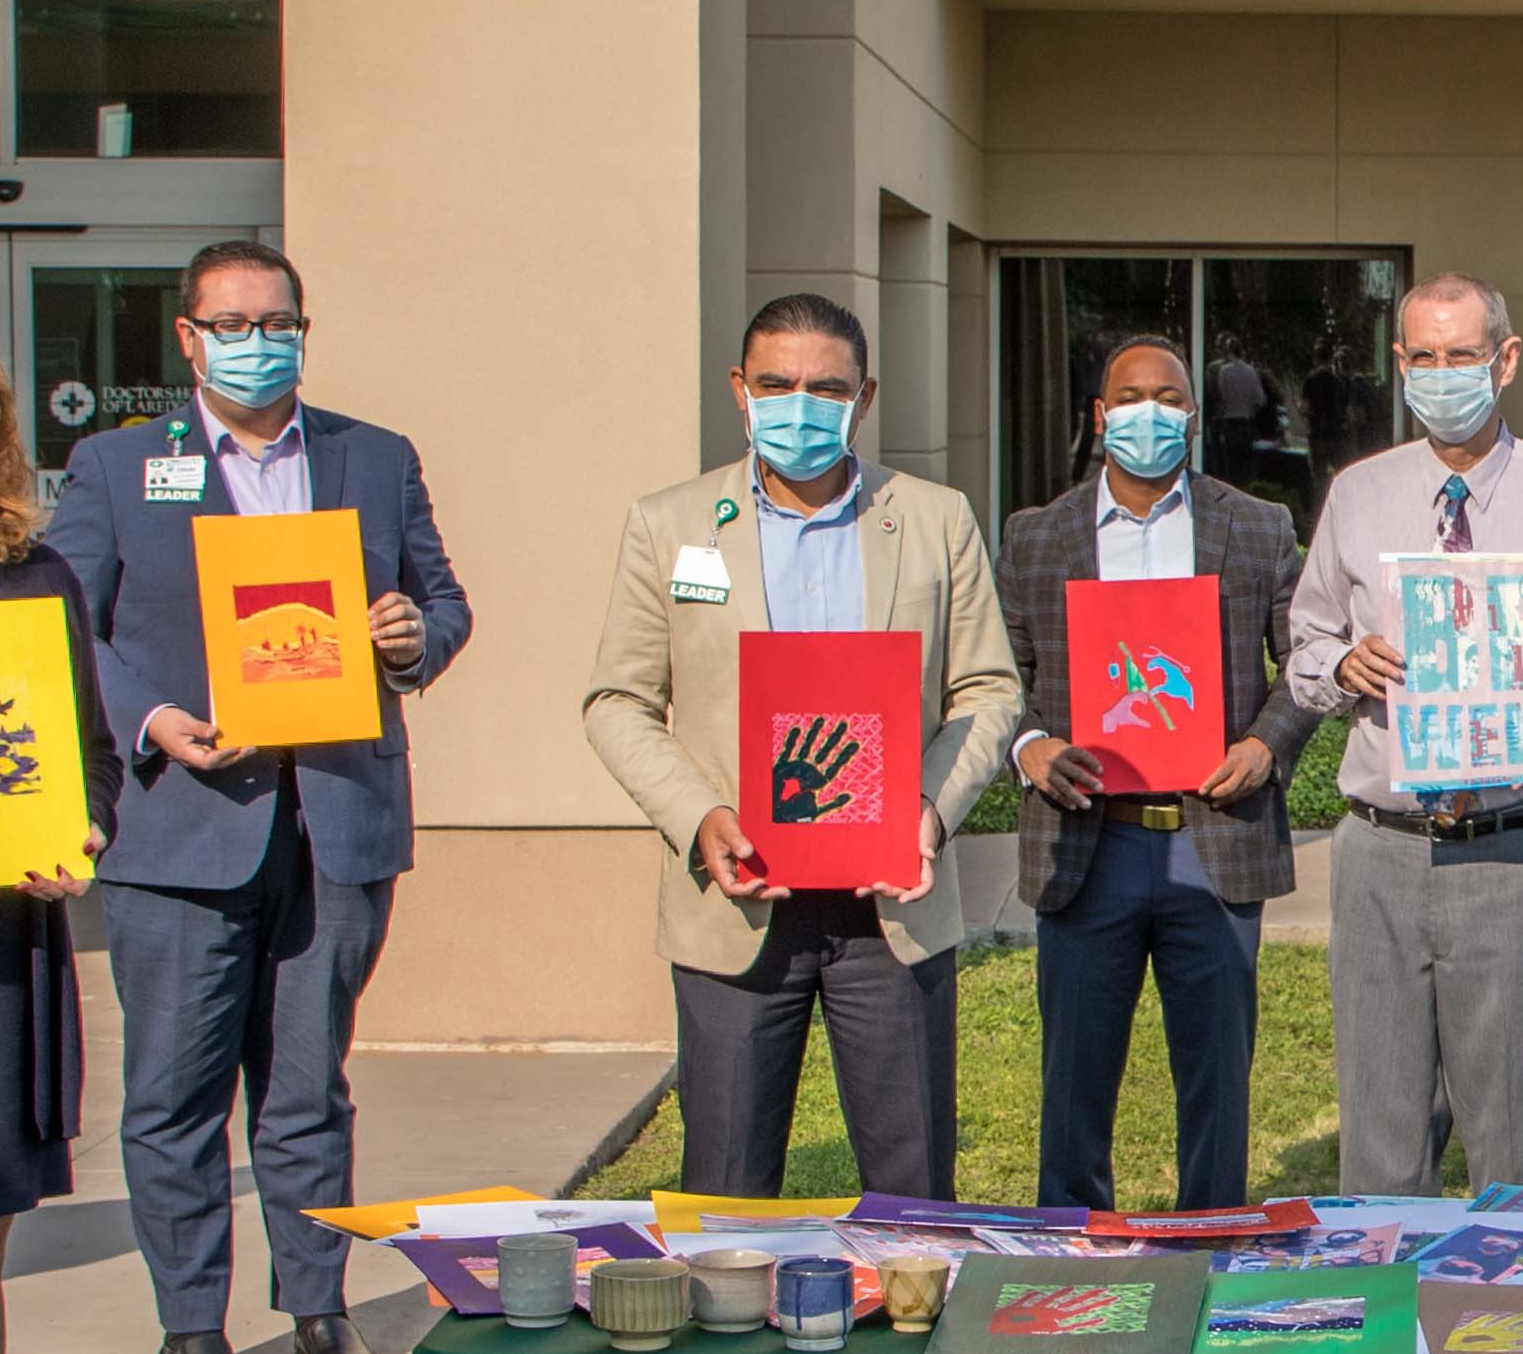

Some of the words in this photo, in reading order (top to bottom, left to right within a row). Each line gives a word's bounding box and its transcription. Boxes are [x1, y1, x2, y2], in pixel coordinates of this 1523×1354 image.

[101, 386, 174, 400] DOCTORS
[146, 489, 200, 502] LEADER
[669, 582, 726, 603] LEADER
